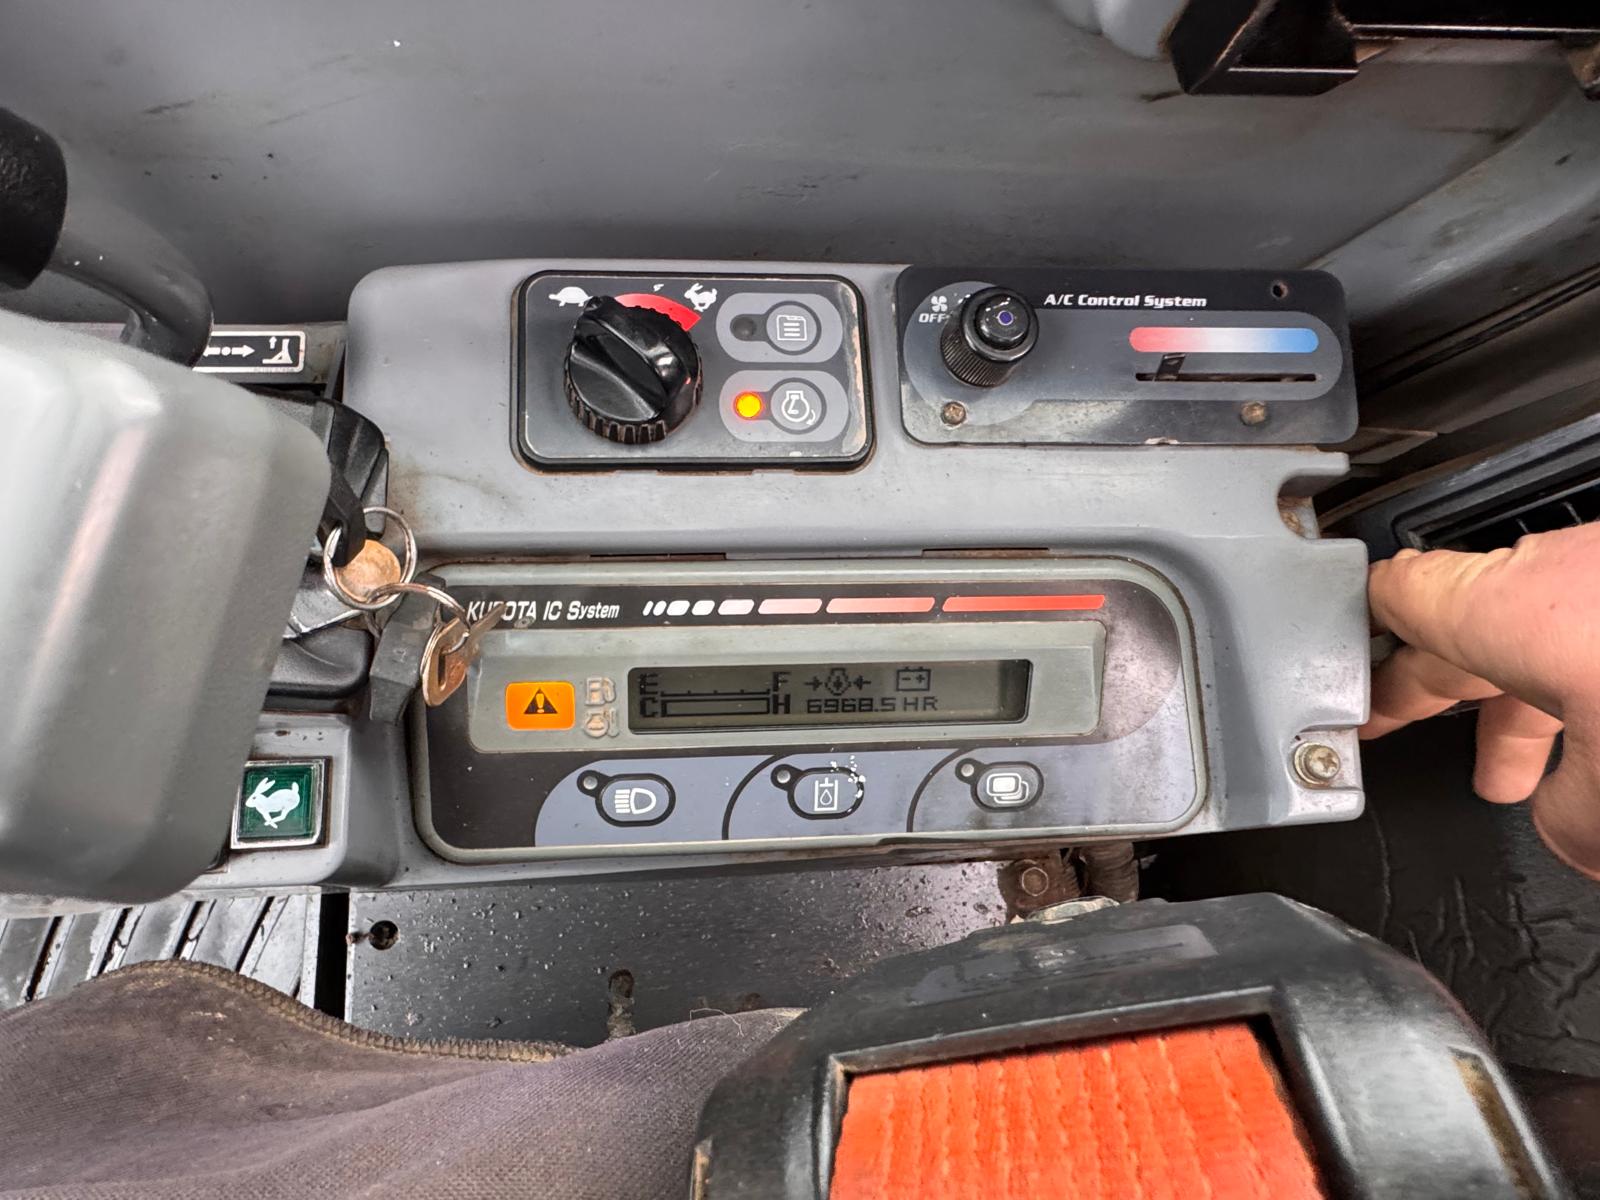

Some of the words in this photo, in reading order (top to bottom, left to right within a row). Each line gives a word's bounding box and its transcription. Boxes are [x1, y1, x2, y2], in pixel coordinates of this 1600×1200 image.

[1044, 294, 1074, 306] A/C
[1078, 294, 1140, 307] Control
[1143, 295, 1207, 309] System
[919, 313, 946, 323] OFF
[543, 601, 563, 620] IC
[567, 601, 620, 620] System
[639, 674, 659, 695] E
[772, 672, 791, 692] F
[639, 697, 659, 717] C
[772, 694, 791, 714] H
[807, 698, 896, 713] 6968.5
[903, 696, 938, 711] HR
